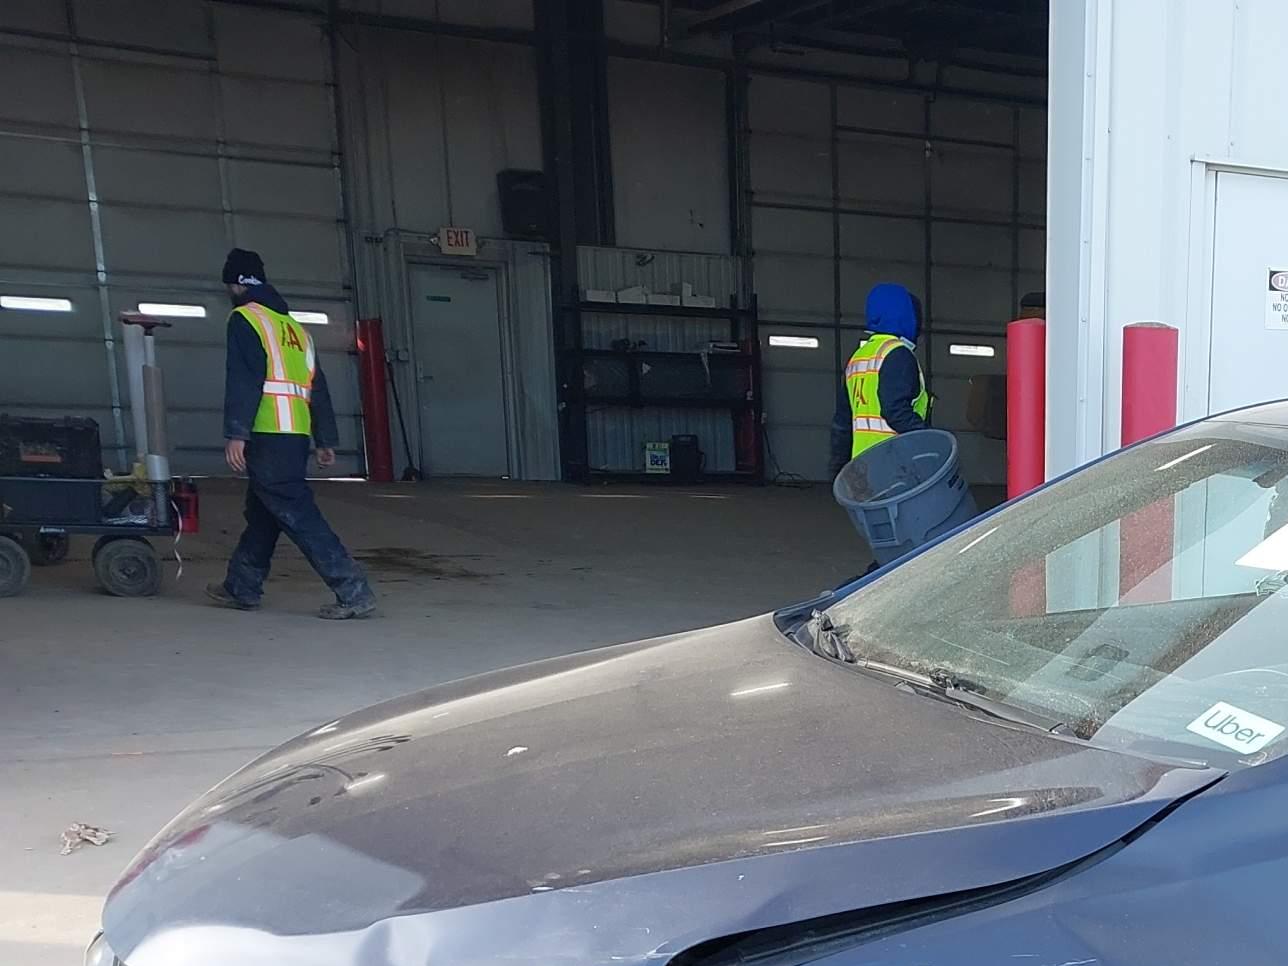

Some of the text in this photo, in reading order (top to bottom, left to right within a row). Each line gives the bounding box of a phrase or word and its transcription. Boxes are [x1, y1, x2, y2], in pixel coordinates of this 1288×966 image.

[447, 230, 470, 247] EXIT
[1272, 303, 1282, 312] NO
[1203, 709, 1265, 745] Uber
